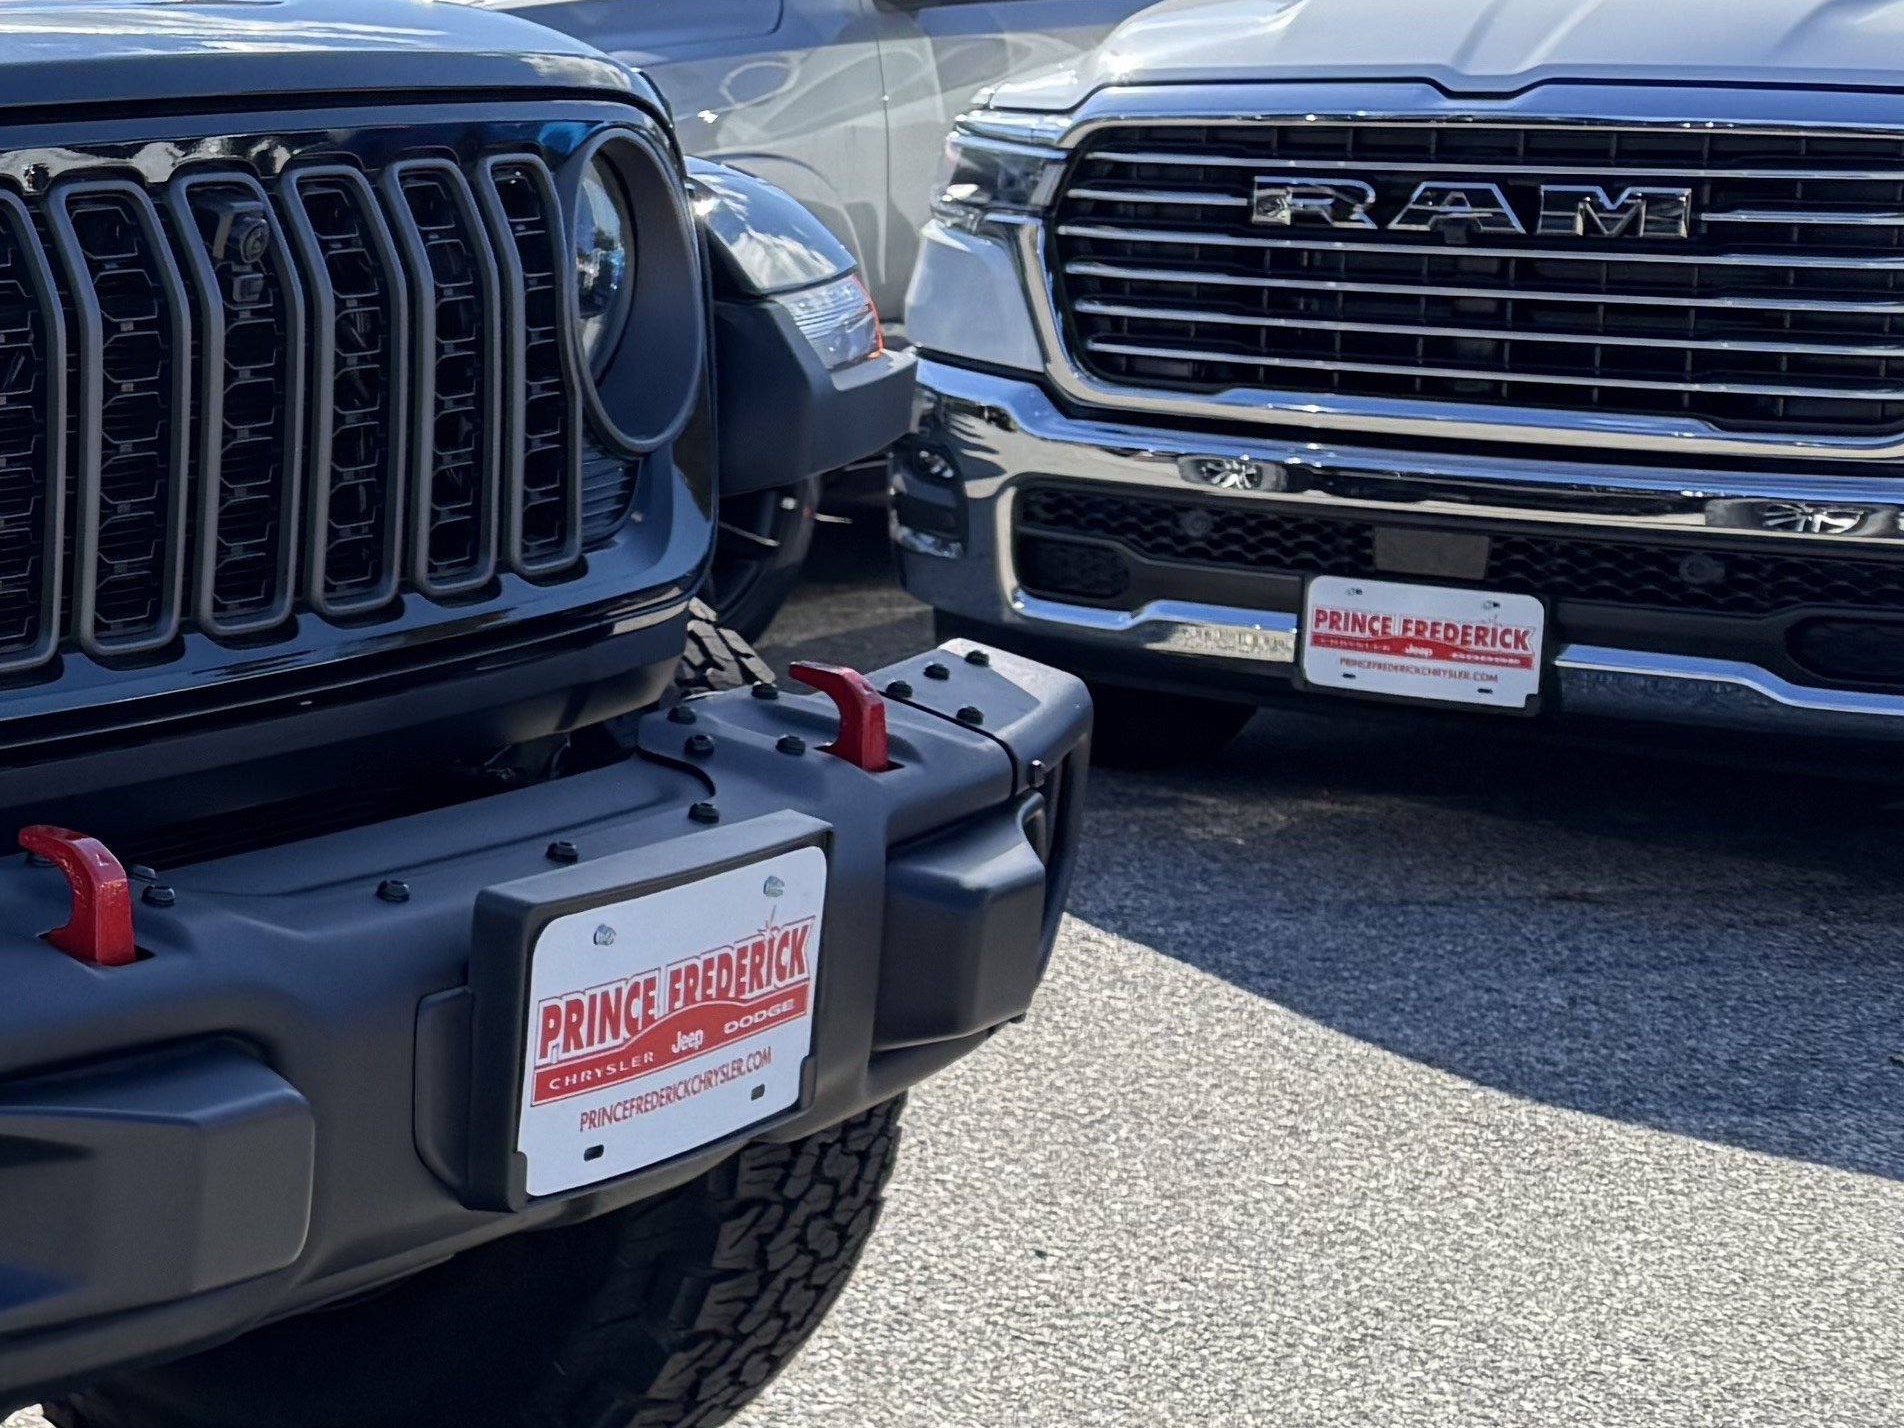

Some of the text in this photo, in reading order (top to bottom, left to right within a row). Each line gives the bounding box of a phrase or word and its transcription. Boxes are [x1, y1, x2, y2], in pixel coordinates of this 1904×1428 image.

[1253, 175, 1692, 239] RAM
[1313, 608, 1393, 637] PRINCE
[1401, 617, 1532, 652] FREDERICK
[537, 922, 814, 1061] PRINCE FREDERICK
[549, 997, 795, 1090] CHRYSLER Jeep DODGE
[579, 1045, 772, 1133] PRINCEFREDERICKCHRYSLER.COM
